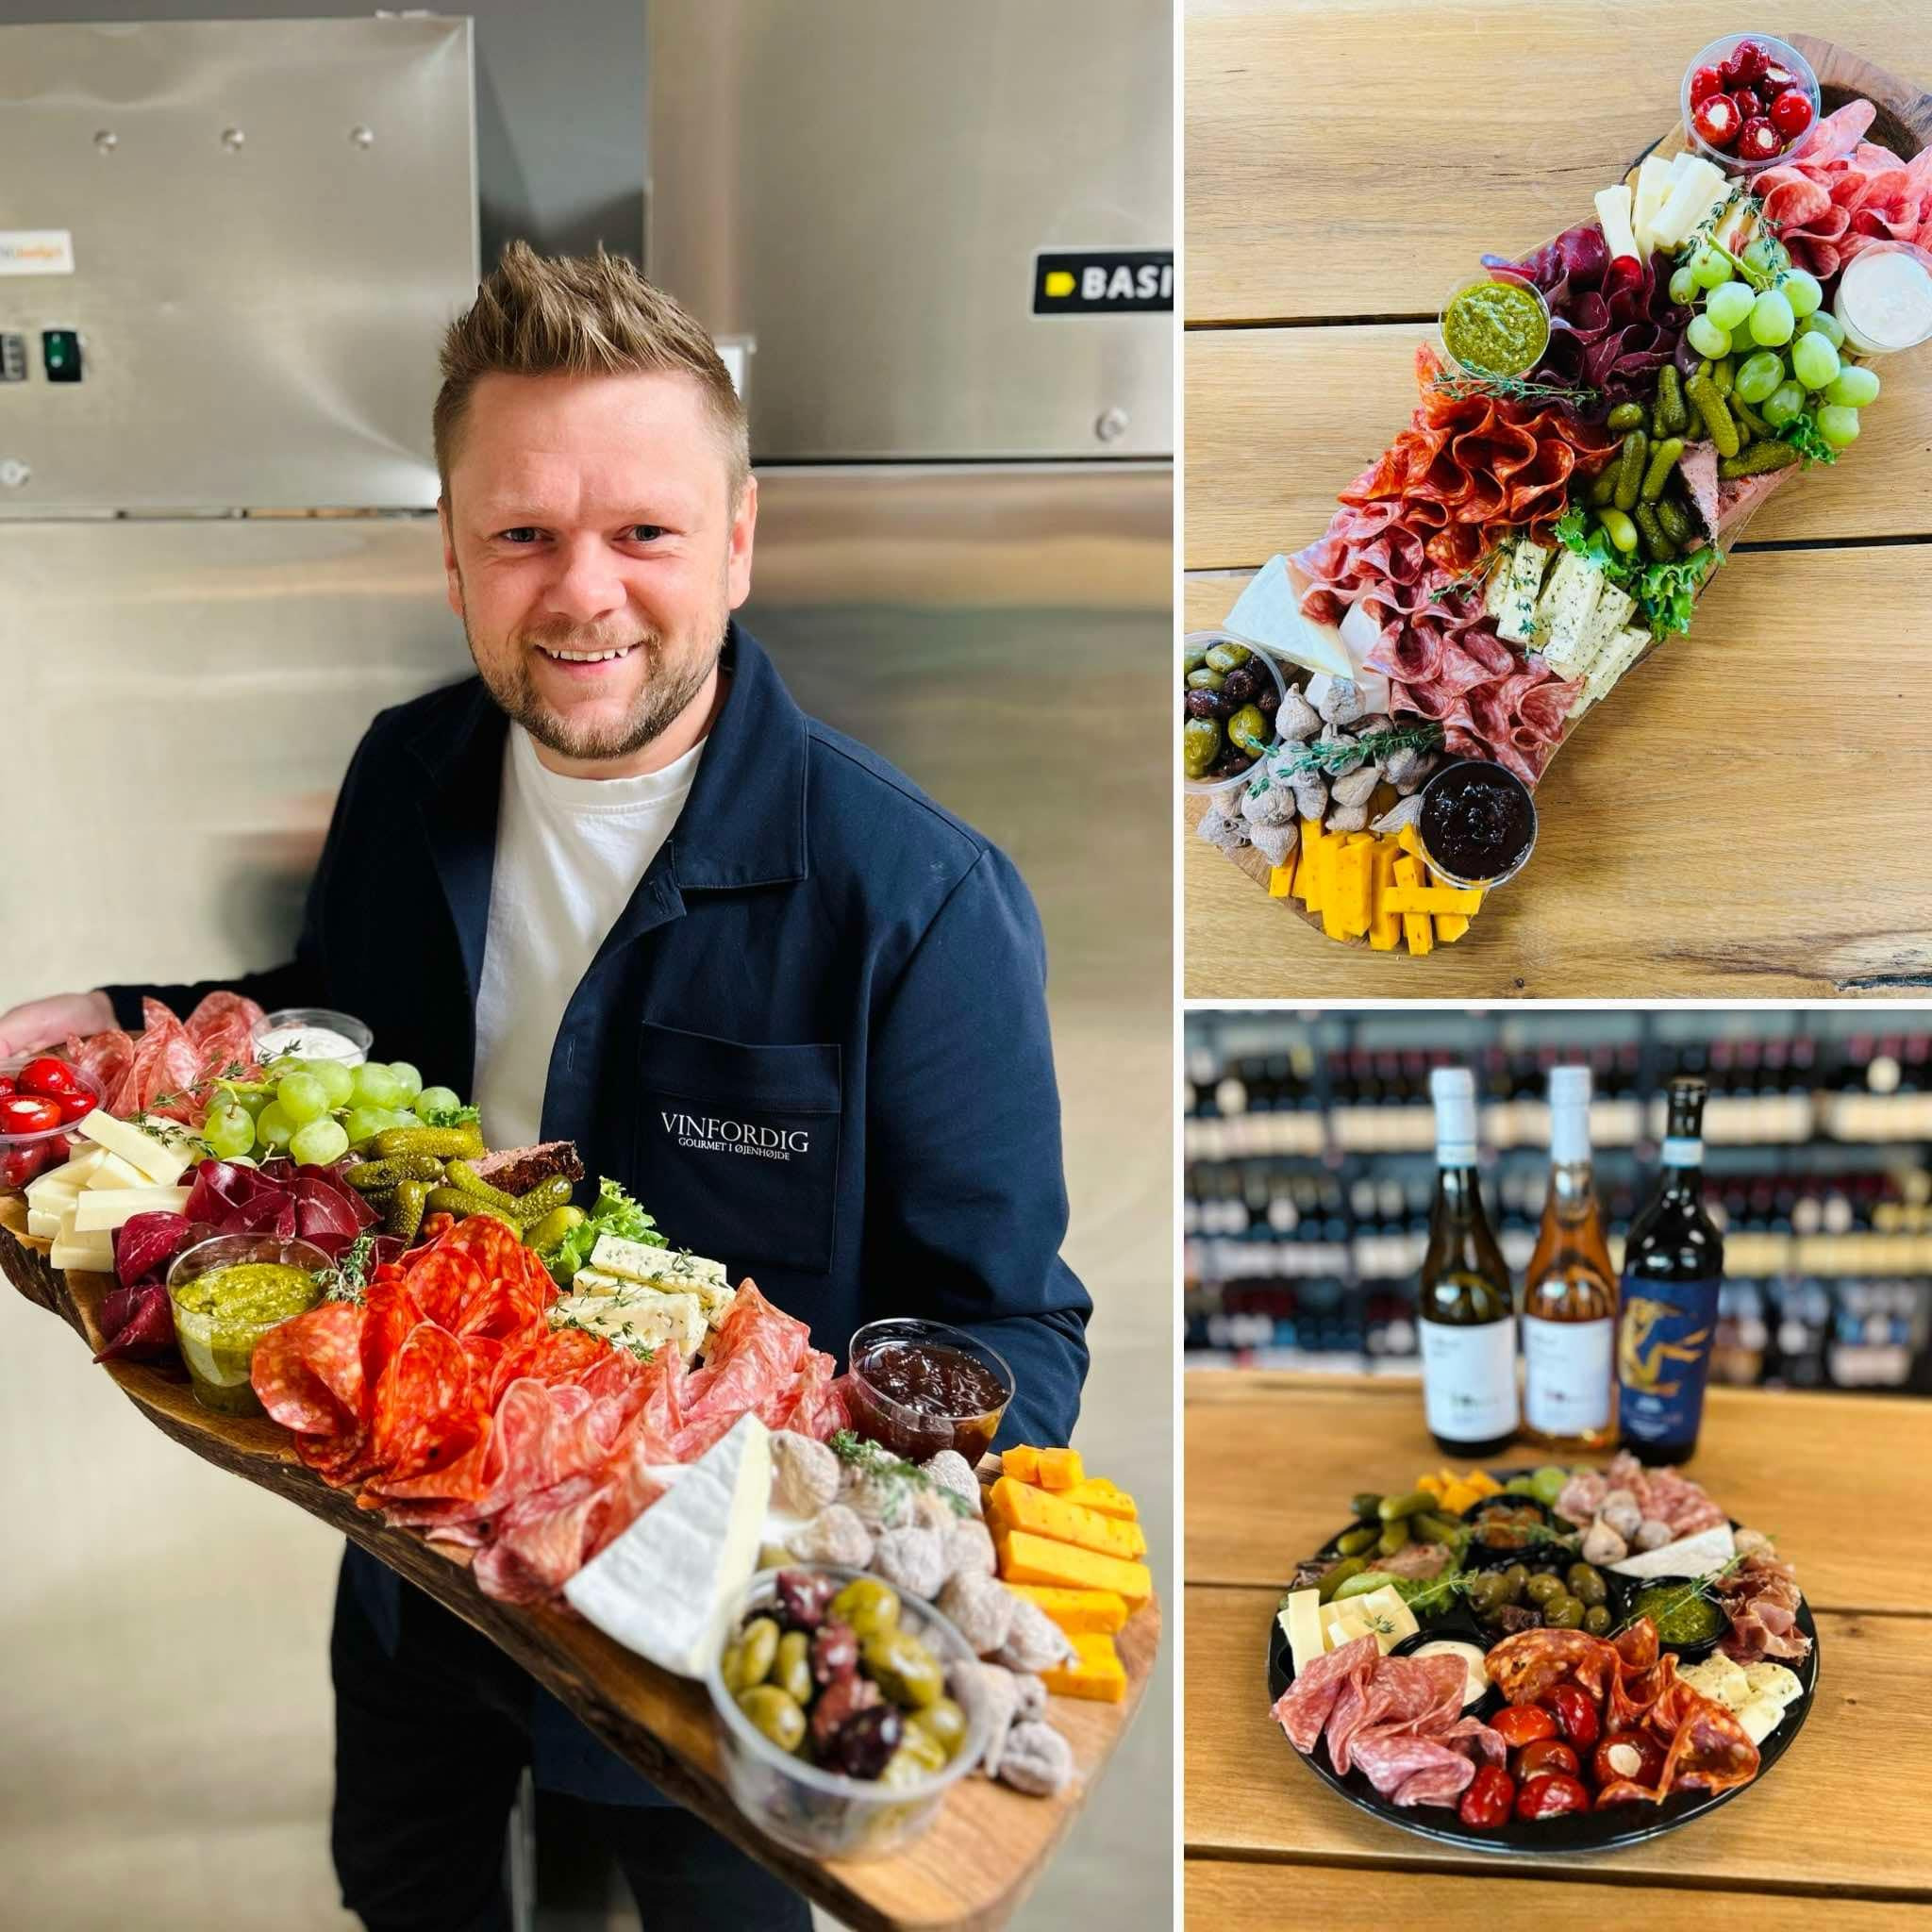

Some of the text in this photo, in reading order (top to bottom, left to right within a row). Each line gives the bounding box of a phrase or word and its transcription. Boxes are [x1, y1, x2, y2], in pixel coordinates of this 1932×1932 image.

[661, 1111, 809, 1153] VINFORDIG
[678, 1137, 726, 1152] GOURMET
[735, 1143, 791, 1161] ØJENHØJDE
